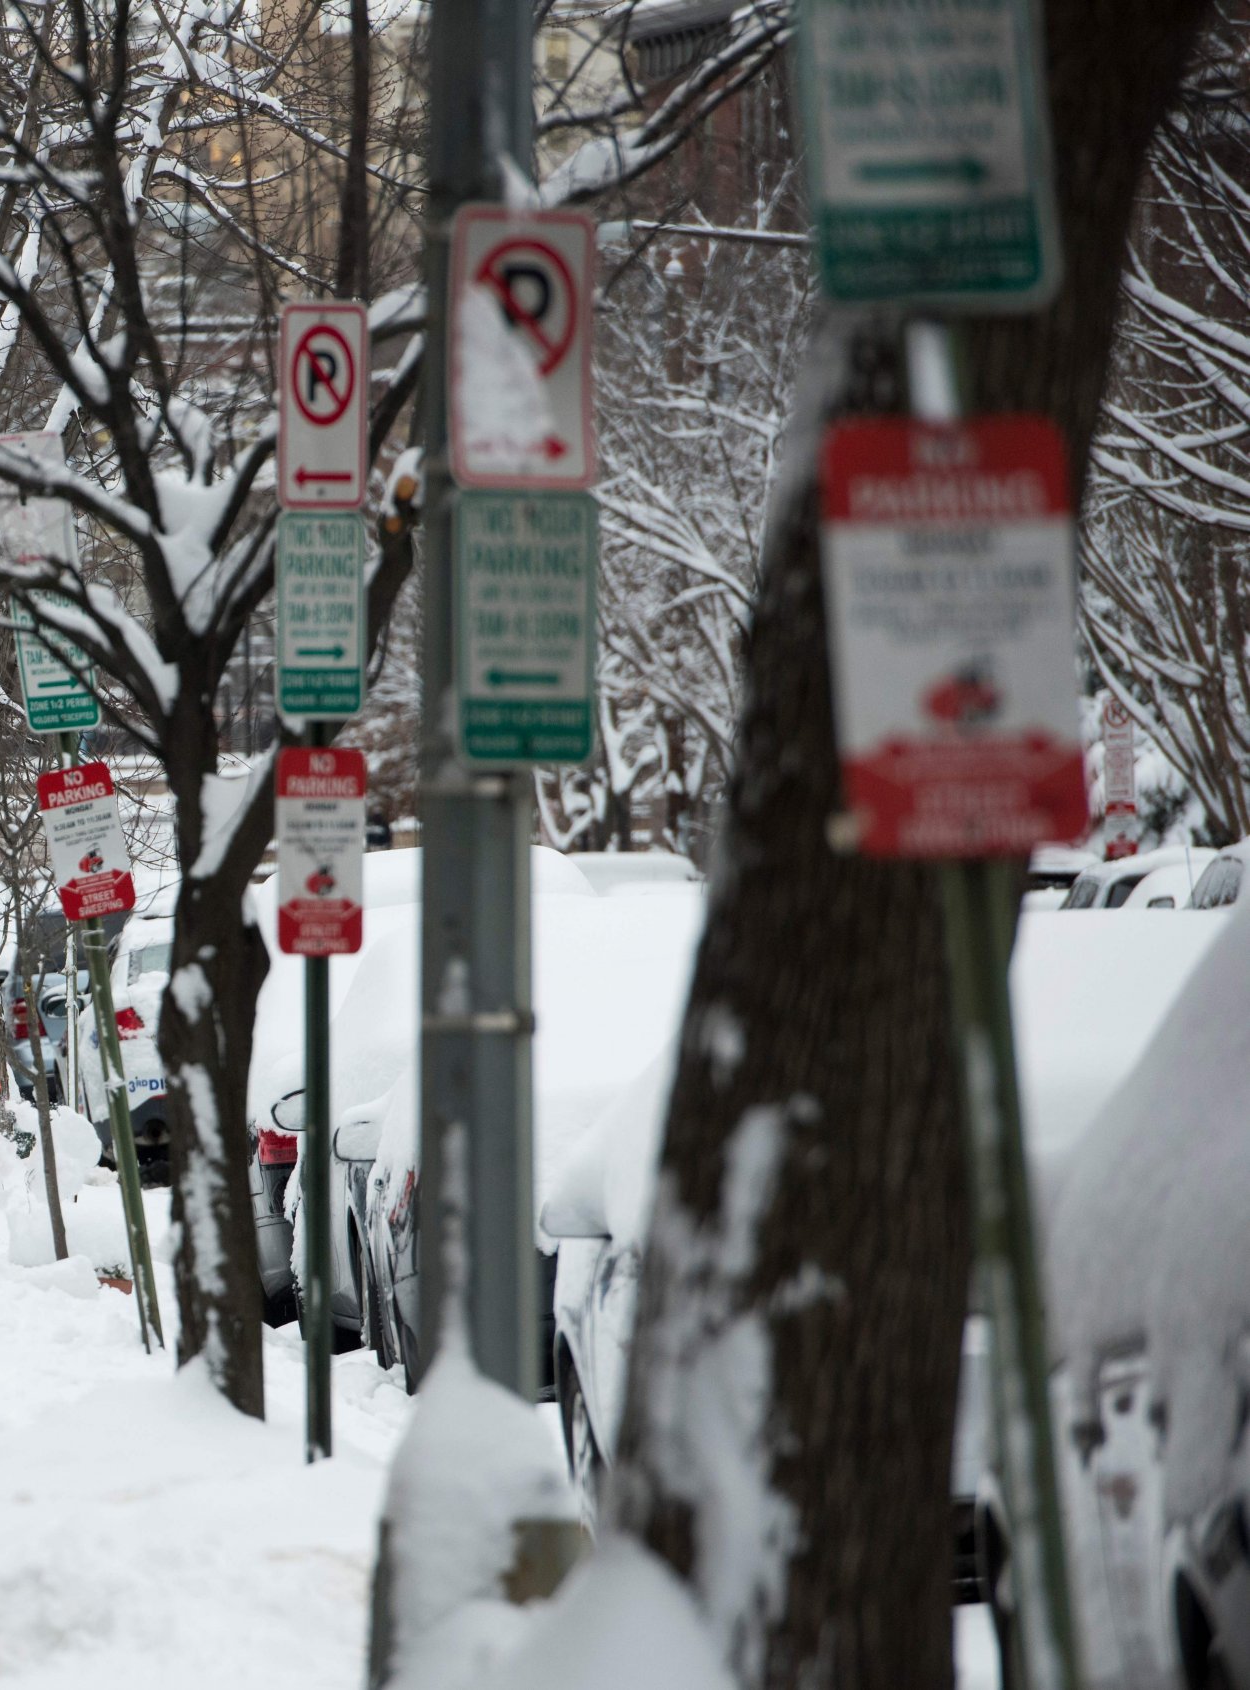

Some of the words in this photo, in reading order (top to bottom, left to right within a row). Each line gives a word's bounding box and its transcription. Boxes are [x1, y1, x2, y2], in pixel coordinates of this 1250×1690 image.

[286, 552, 354, 578] PARKING
[30, 701, 49, 712] ZONE
[66, 696, 93, 708] PERMIT
[309, 753, 336, 774] NO
[63, 771, 84, 787] NO
[286, 776, 358, 795] PARKING
[48, 782, 106, 807] PARKING
[64, 803, 93, 815] MONDAY
[82, 889, 115, 905] STREET
[78, 898, 123, 917] SWEEPING
